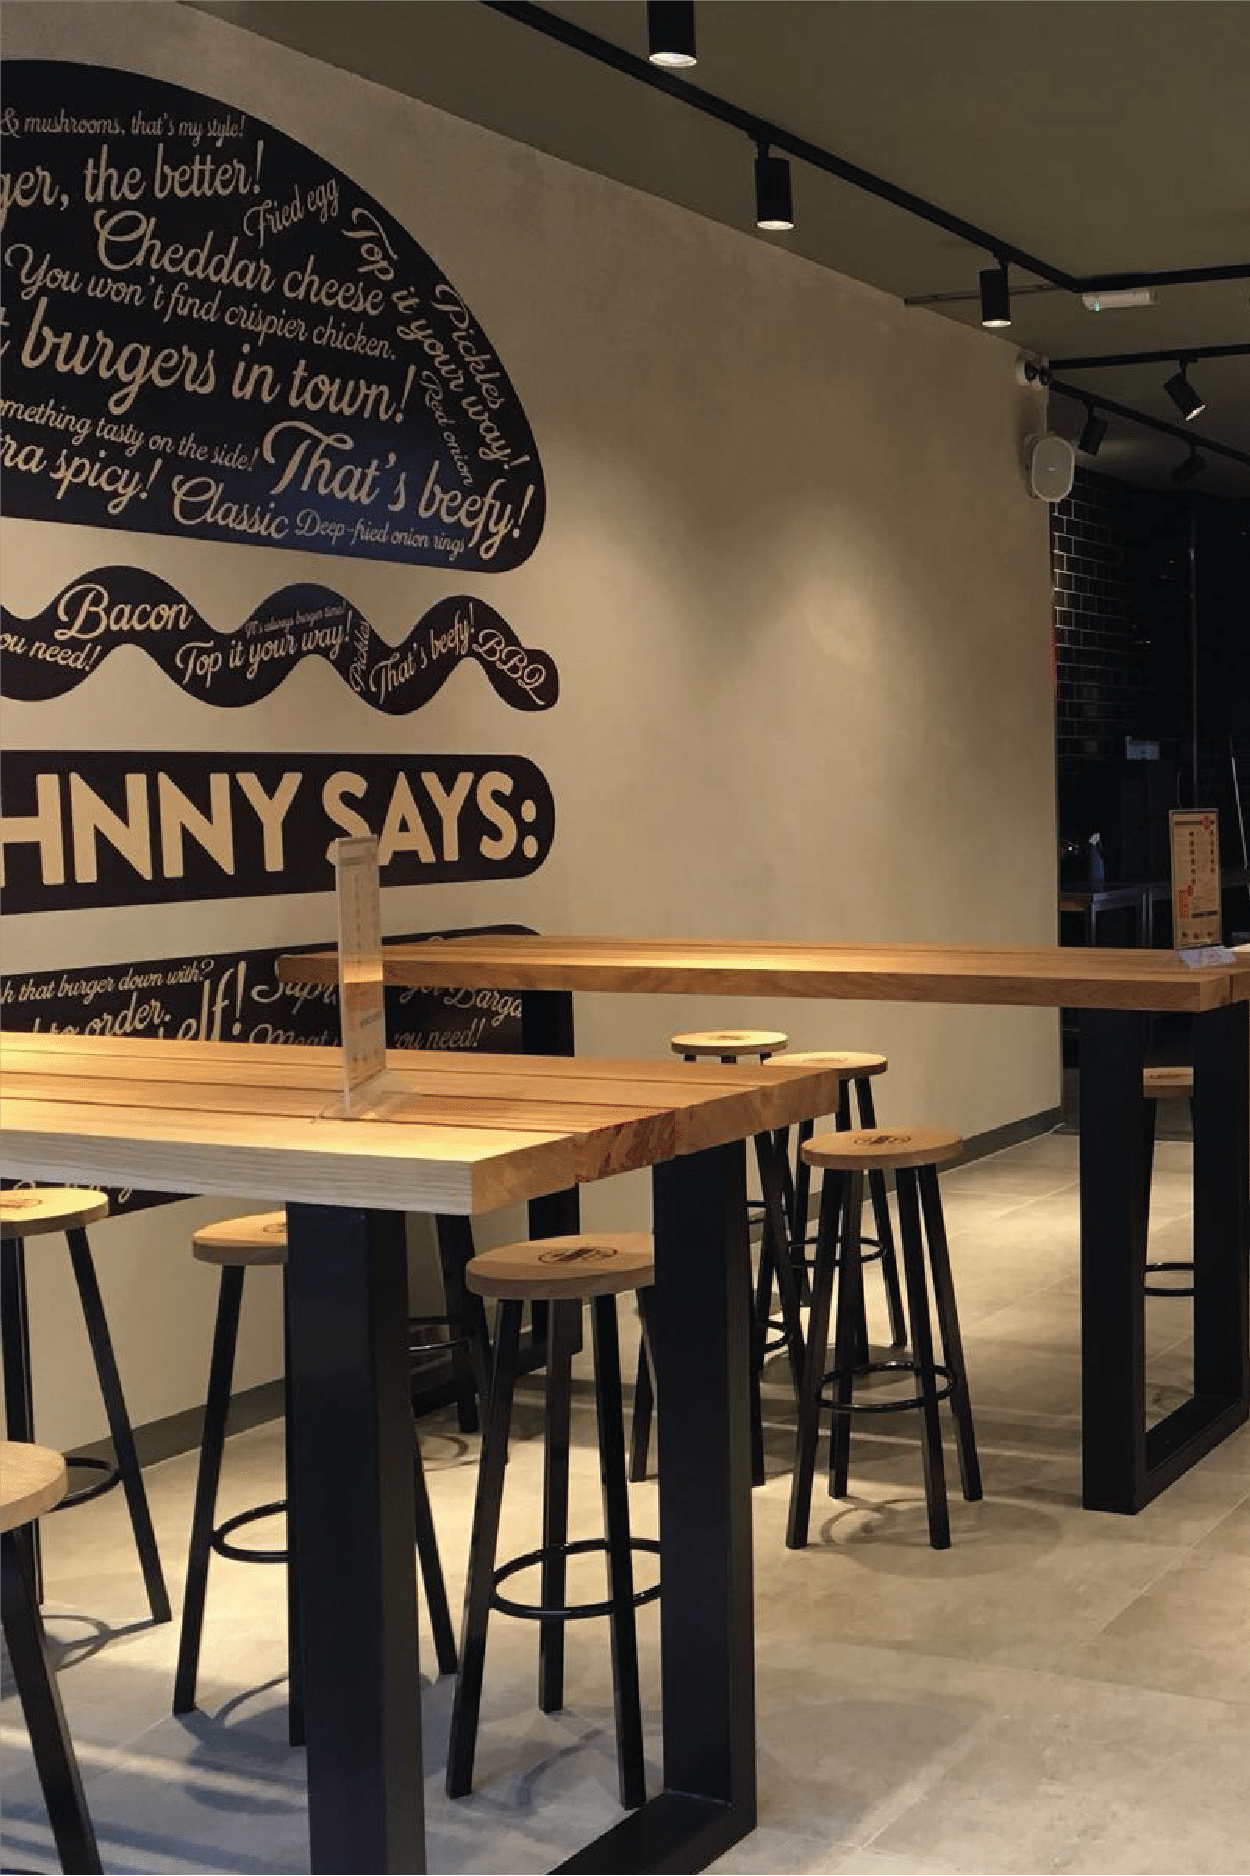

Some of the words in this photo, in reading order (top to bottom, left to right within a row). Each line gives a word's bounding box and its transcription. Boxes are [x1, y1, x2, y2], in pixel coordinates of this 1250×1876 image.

[179, 121, 202, 147] my
[83, 142, 147, 203] the
[154, 139, 264, 200] better!
[243, 182, 305, 250] Fried
[307, 178, 340, 222] egg
[5, 243, 83, 300] You
[87, 274, 165, 311] won't
[162, 281, 222, 323] find
[224, 301, 309, 346] crispier
[94, 208, 276, 294] Cheddar
[282, 254, 385, 316] cheese
[341, 206, 398, 281] Top
[396, 318, 465, 392] your
[20, 296, 217, 416] burgers
[231, 343, 281, 404] in
[288, 359, 417, 423] town!
[96, 417, 145, 457] tasty
[148, 434, 175, 453] on
[179, 431, 209, 461] the
[210, 442, 260, 472] side!
[49, 448, 163, 515] spicy!
[171, 474, 289, 539] Classic
[262, 420, 407, 512] That's
[419, 478, 537, 560] beefy!
[54, 583, 194, 640] Bacon
[175, 639, 223, 689] Top
[229, 639, 246, 670] it
[248, 633, 299, 680] your
[301, 610, 354, 661] way!
[368, 642, 428, 704] That's
[321, 770, 539, 867] SAYS:
[19, 978, 55, 1003] that
[57, 973, 116, 1006] burger
[118, 965, 164, 991] down
